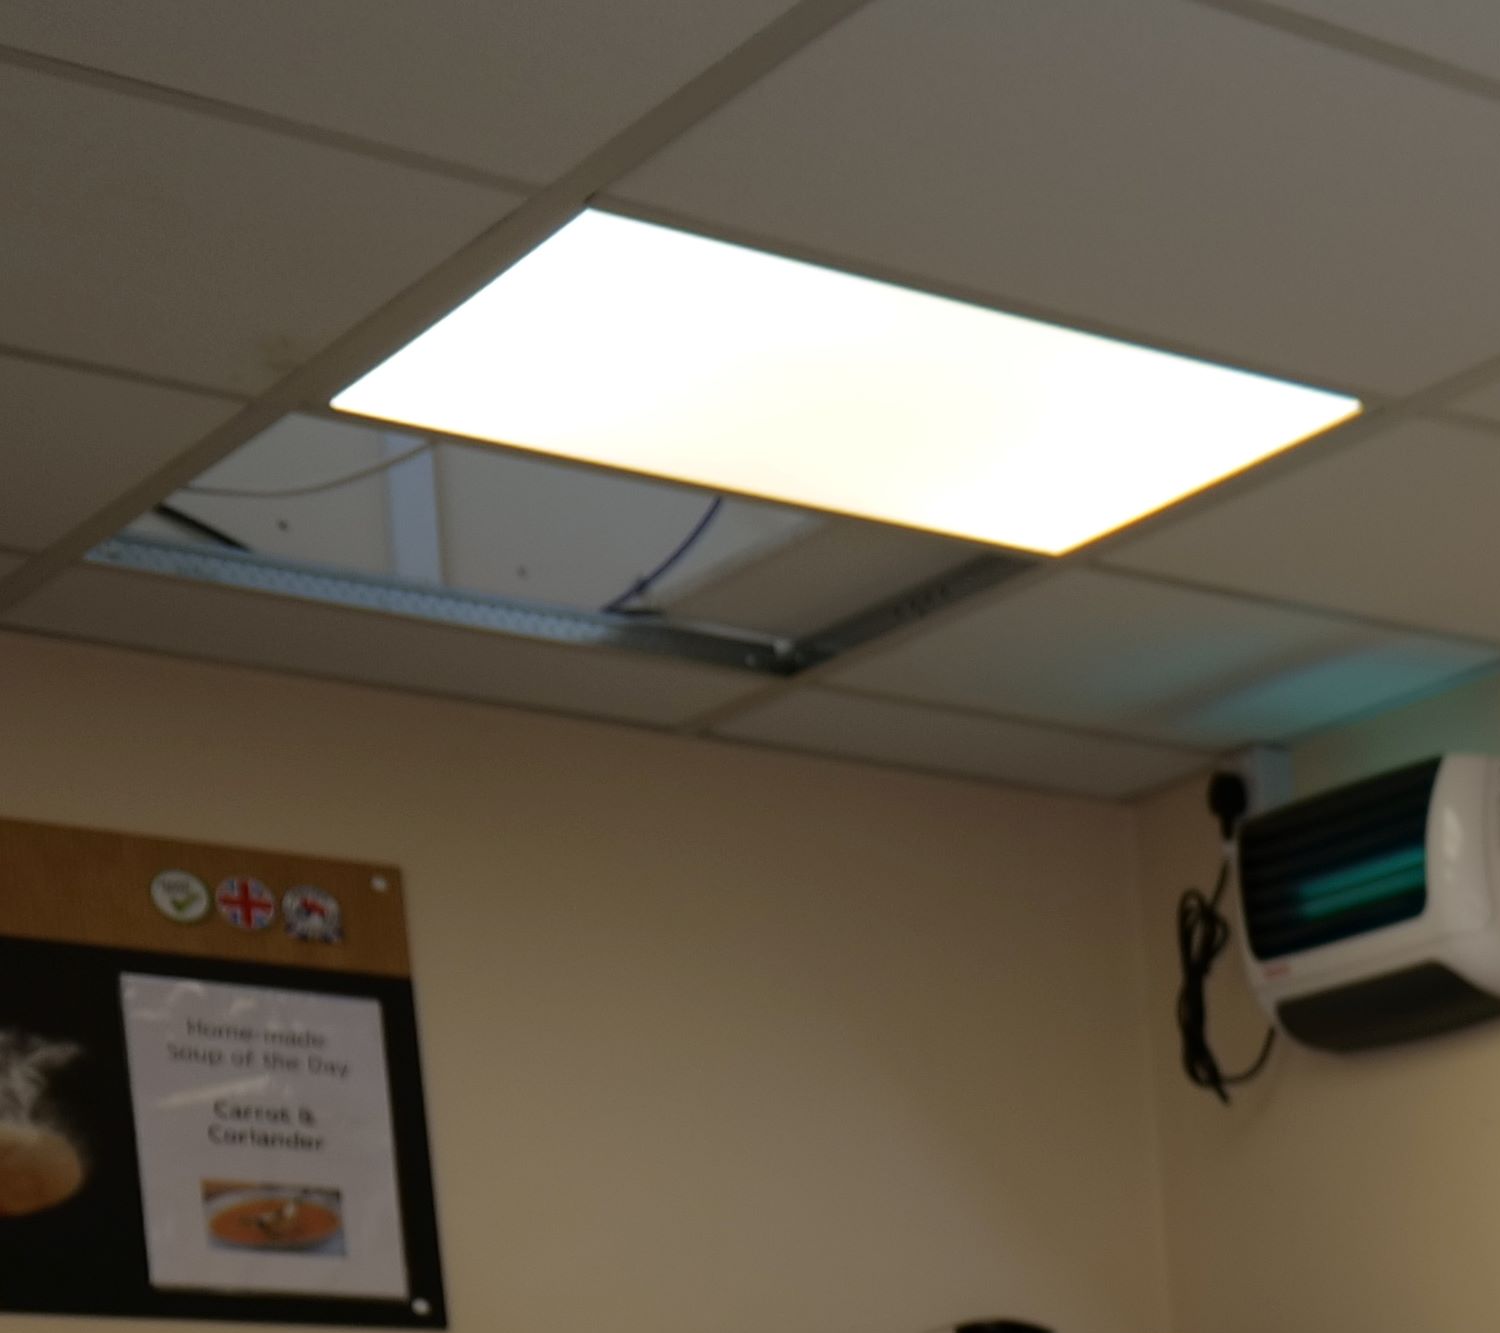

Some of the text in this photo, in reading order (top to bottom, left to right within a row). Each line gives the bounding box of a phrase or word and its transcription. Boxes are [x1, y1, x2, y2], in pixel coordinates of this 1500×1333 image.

[167, 1040, 350, 1078] Soup of the Day
[213, 1098, 291, 1126] Carrot
[207, 1122, 325, 1152] Coriander
